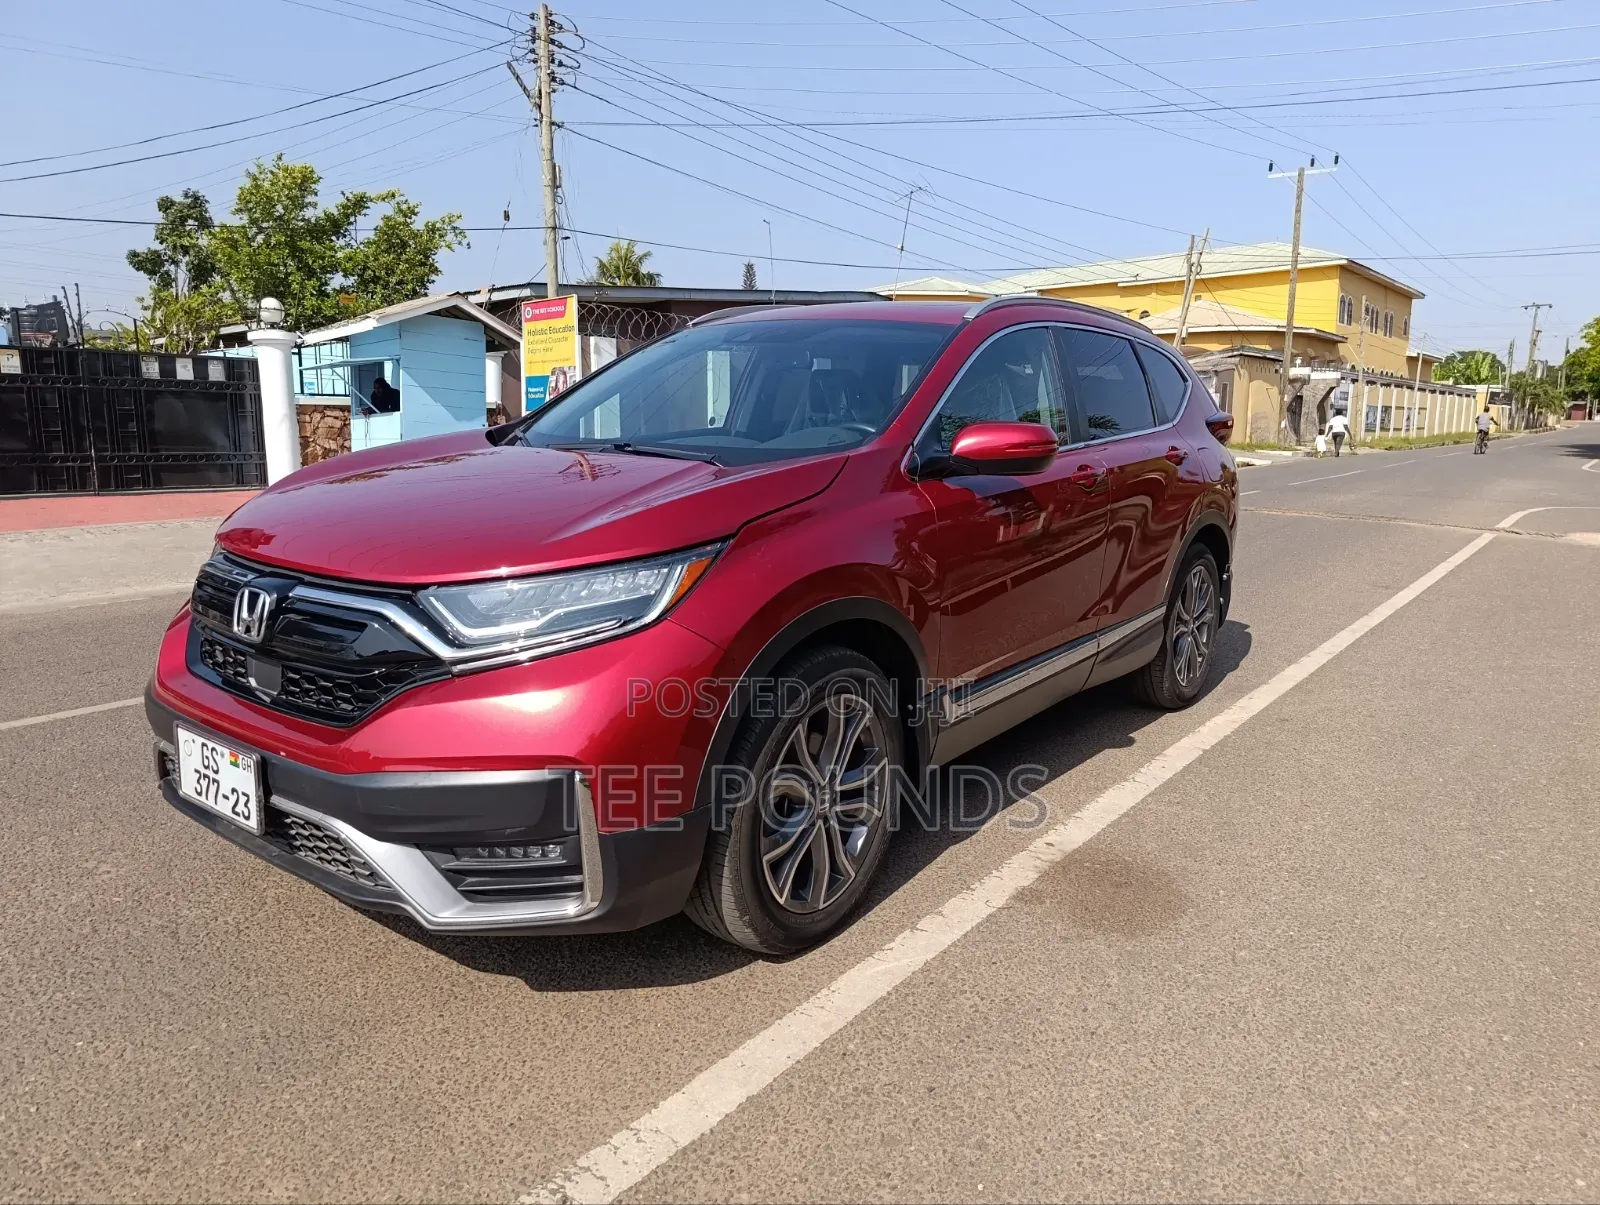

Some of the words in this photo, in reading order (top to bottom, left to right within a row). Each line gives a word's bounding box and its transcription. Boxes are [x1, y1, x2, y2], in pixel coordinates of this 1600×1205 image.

[548, 305, 565, 313] SCHOOLS
[527, 327, 548, 337] Holistic
[548, 324, 575, 334] Education
[548, 335, 569, 344] Character
[201, 741, 220, 775] GS
[241, 757, 252, 774] GH
[194, 768, 251, 821] 377-23
